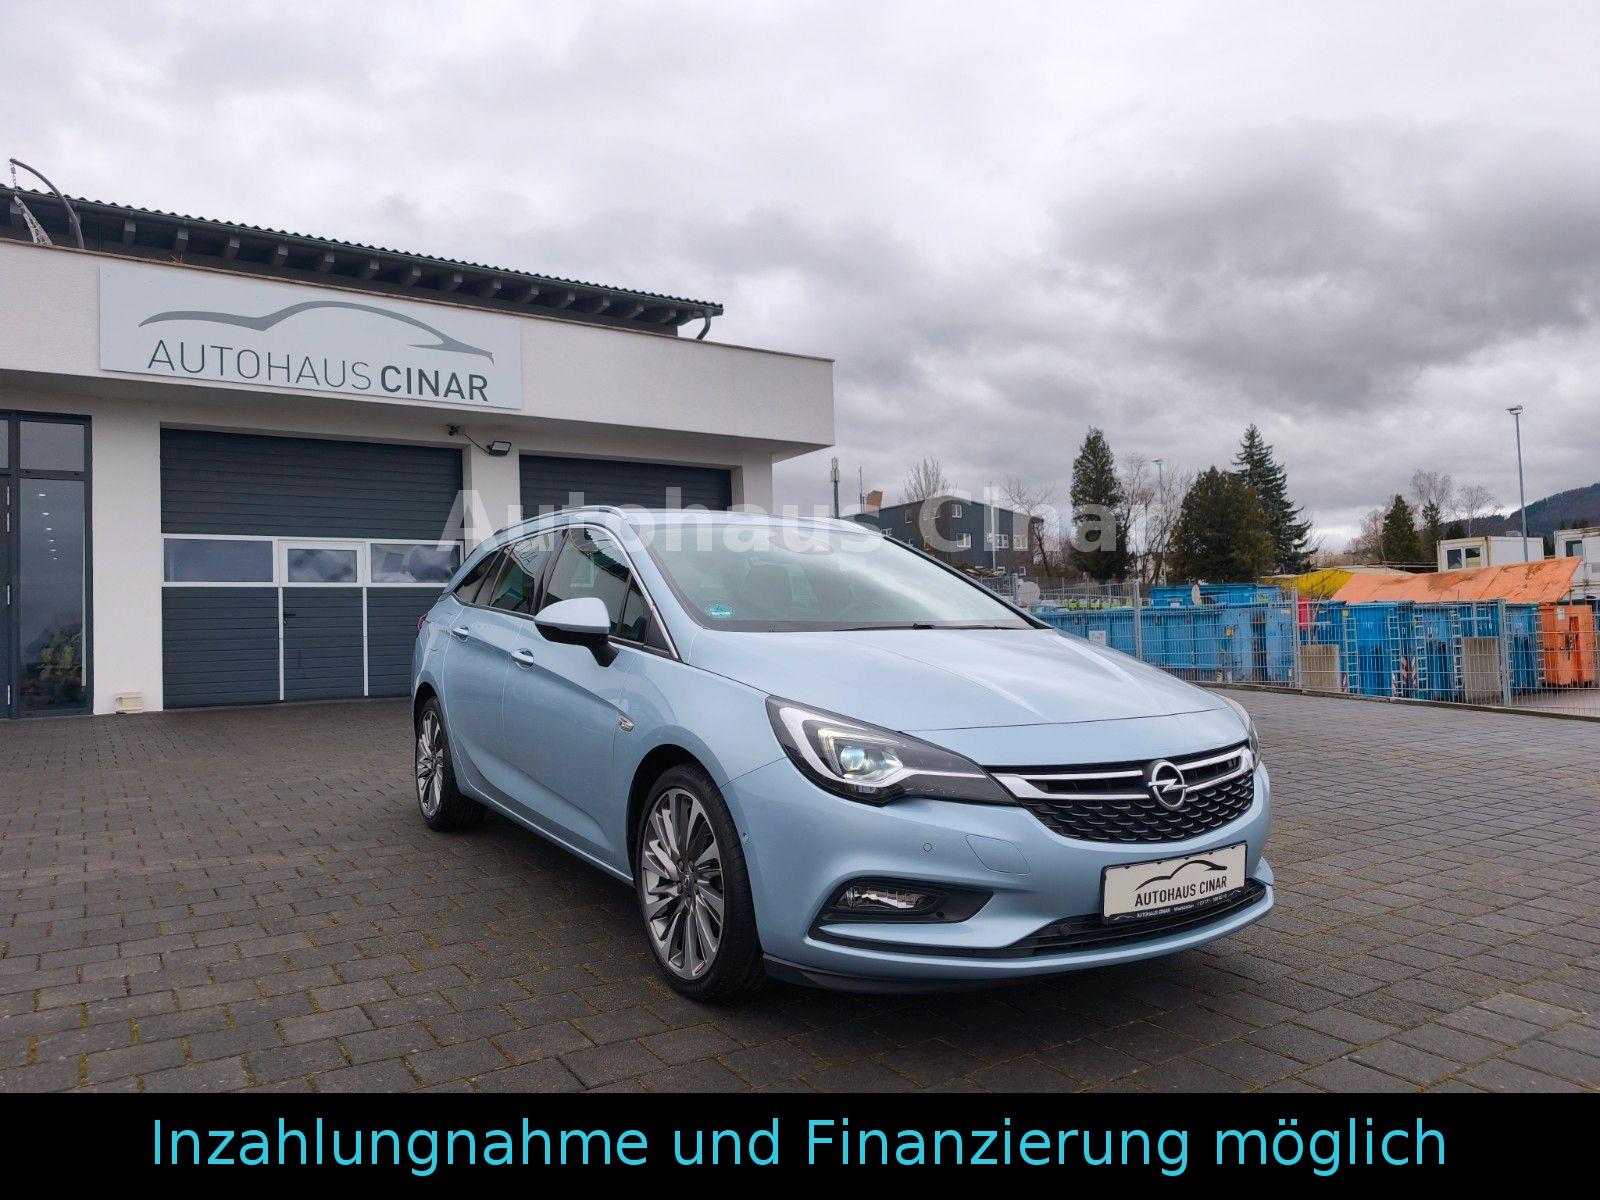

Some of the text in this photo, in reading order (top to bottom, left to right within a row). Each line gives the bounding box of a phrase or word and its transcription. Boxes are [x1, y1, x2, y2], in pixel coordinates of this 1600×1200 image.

[147, 339, 488, 402] AUTOHAUS CINAR
[1135, 884, 1196, 907] AUTOHAUS
[1199, 876, 1227, 894] CINAR
